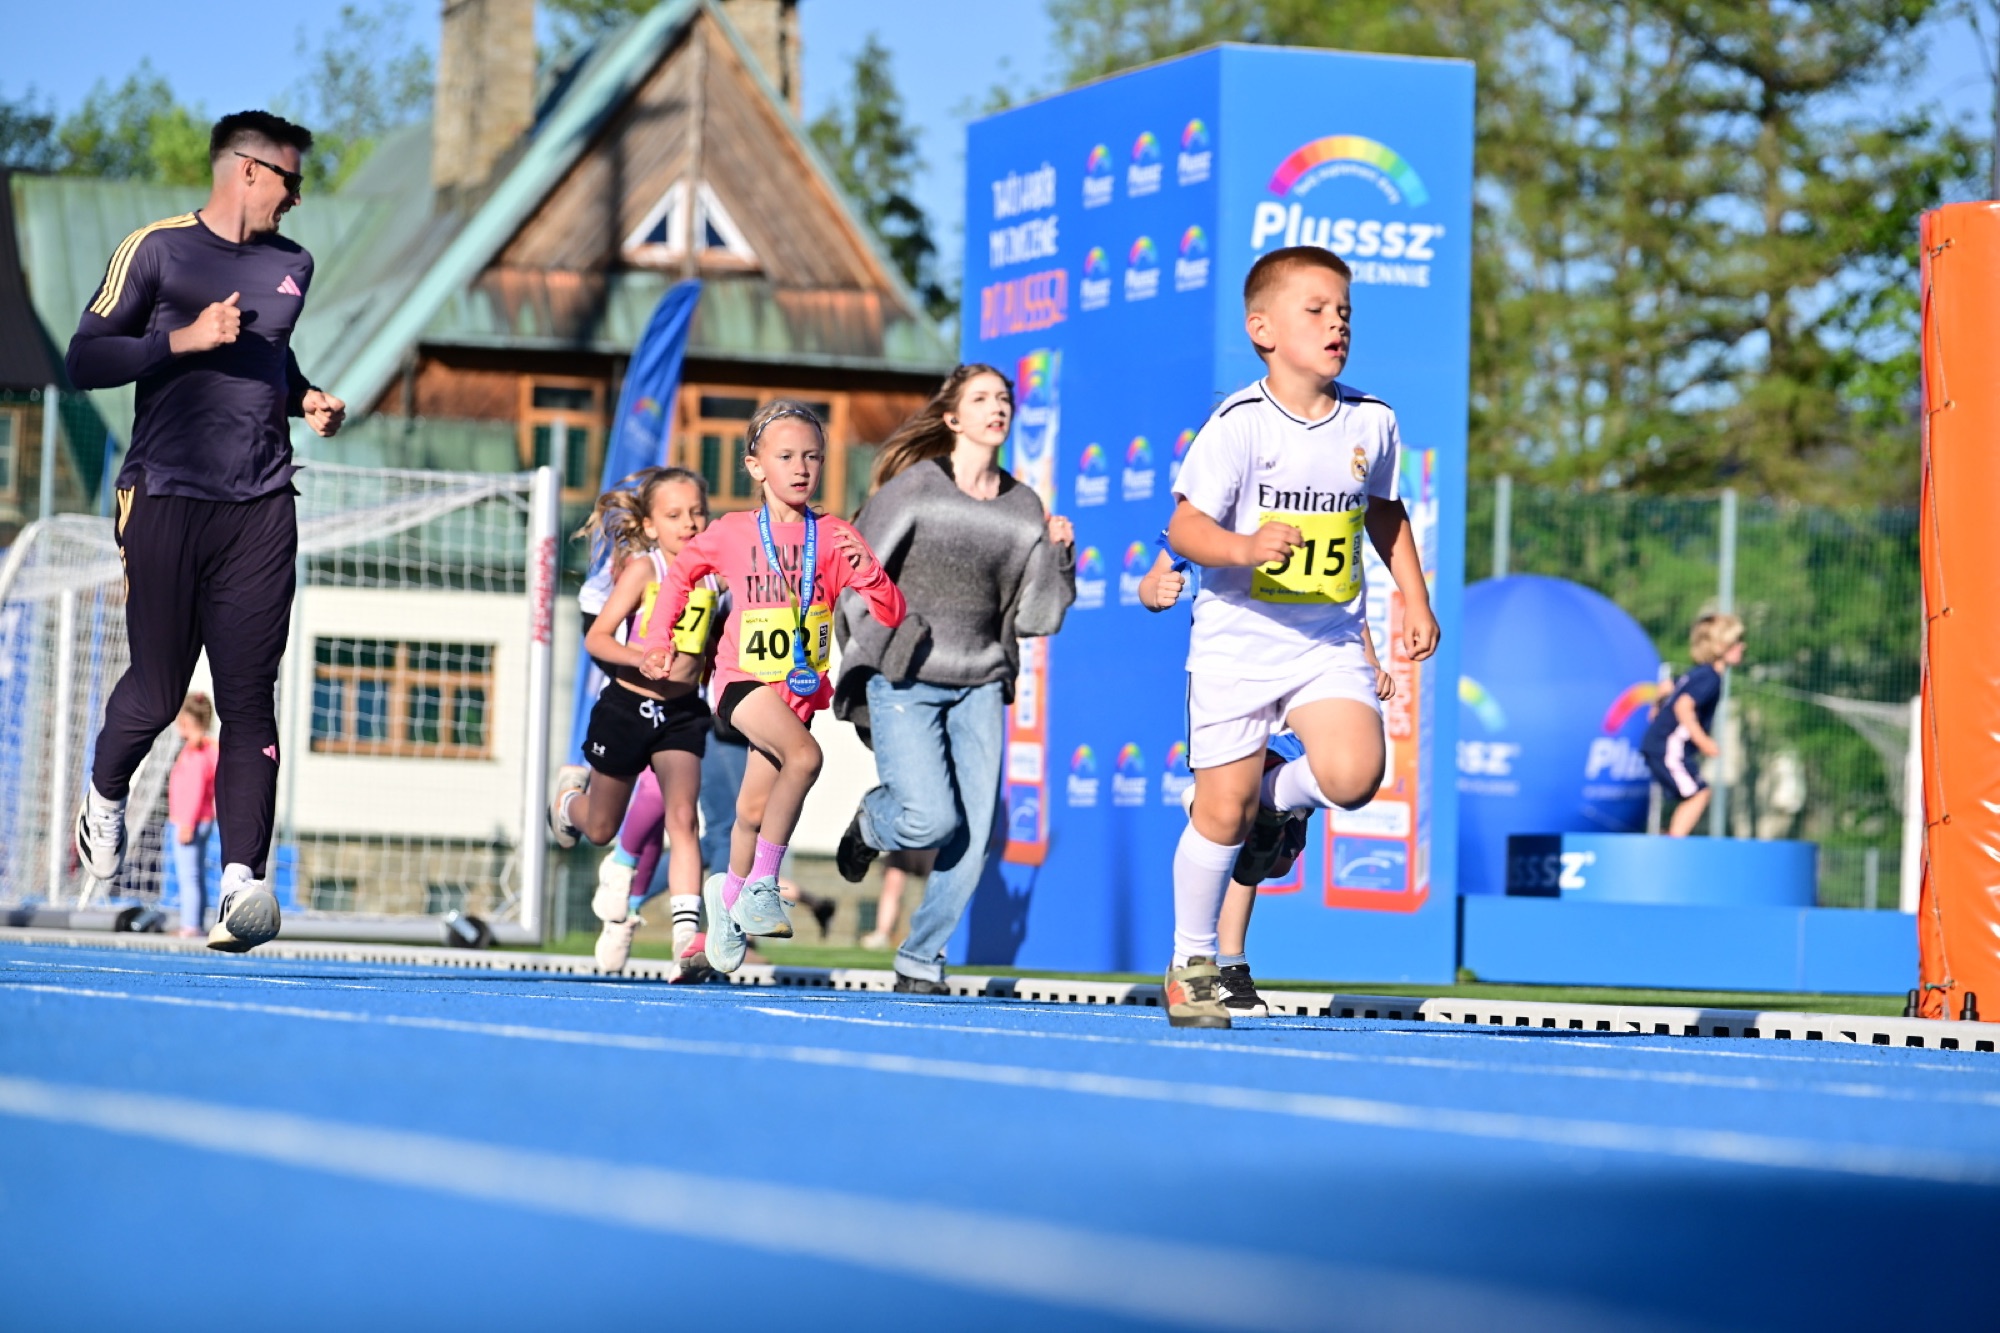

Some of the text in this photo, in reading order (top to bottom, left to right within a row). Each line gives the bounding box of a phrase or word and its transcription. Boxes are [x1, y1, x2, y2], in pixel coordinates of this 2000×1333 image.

[806, 541, 815, 557] RUN
[804, 557, 814, 582] NIGHT
[745, 627, 812, 662] 402
[1585, 736, 1650, 781] Plu
